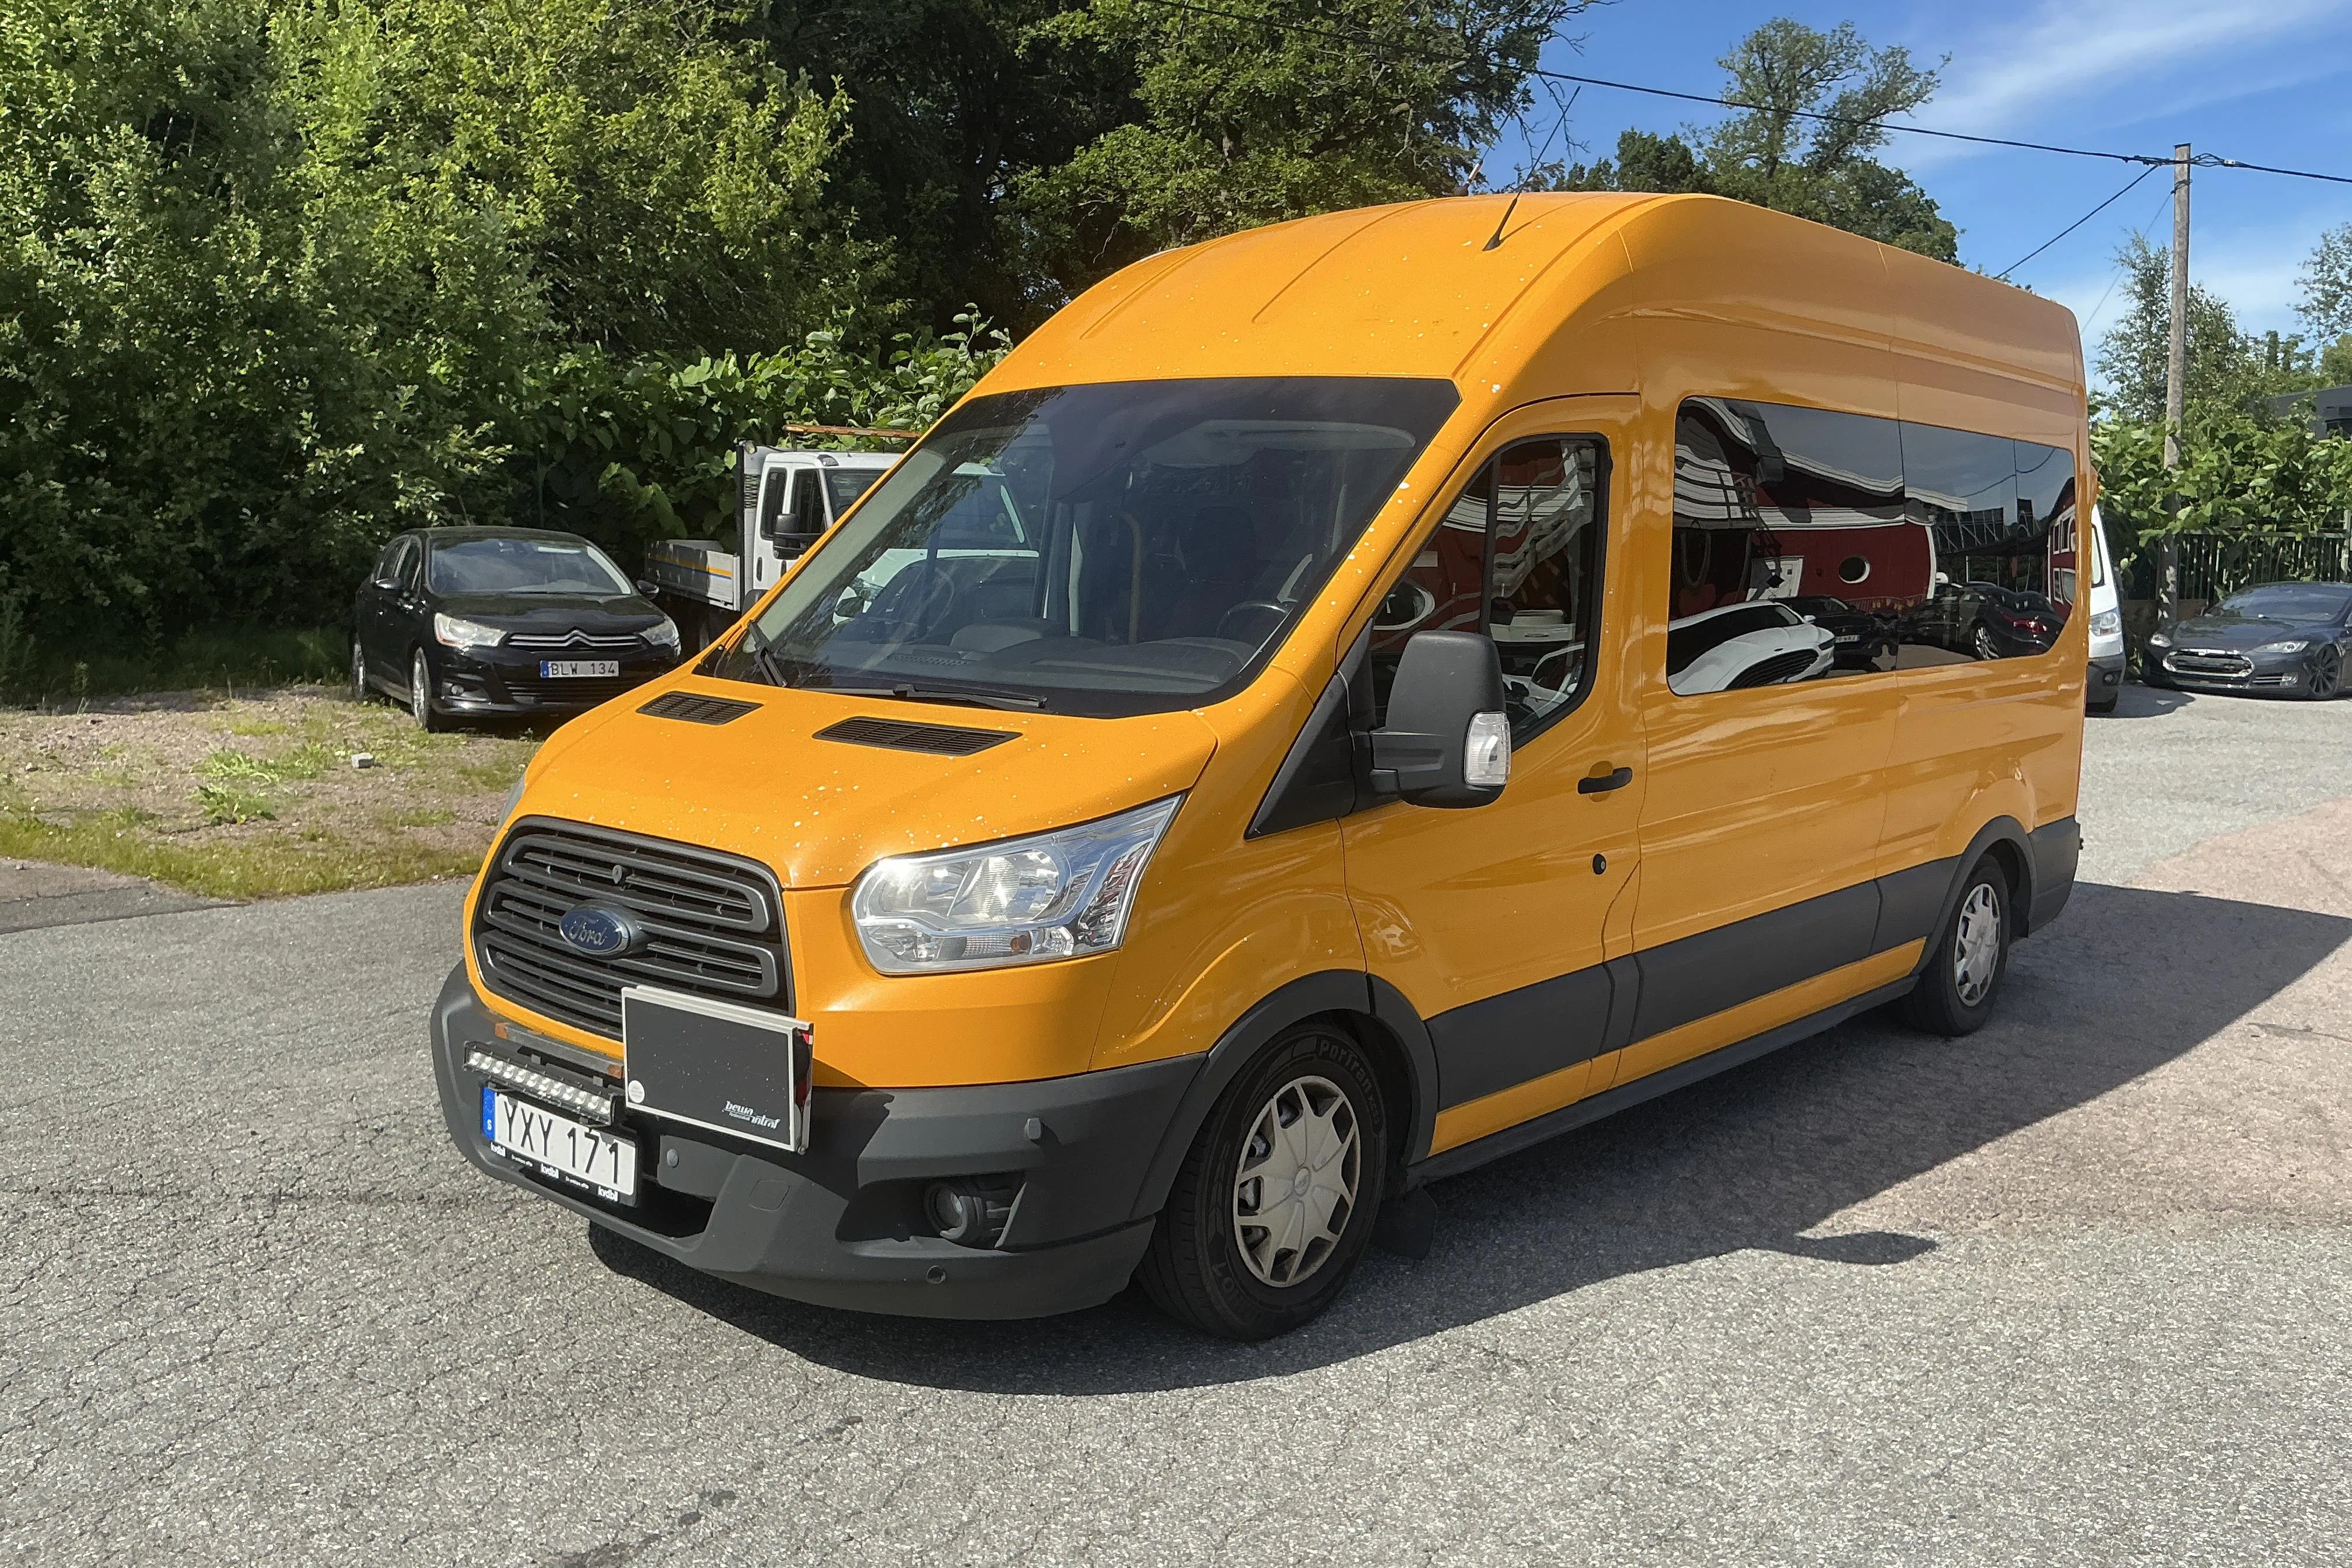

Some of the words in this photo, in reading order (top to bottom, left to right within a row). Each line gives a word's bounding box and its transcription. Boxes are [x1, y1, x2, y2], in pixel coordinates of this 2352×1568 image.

[550, 663, 578, 676] BLW
[591, 662, 615, 675] 134
[569, 915, 608, 946] Ford
[487, 1119, 492, 1130] S
[504, 1100, 553, 1157] YXY
[567, 1126, 618, 1185] 171
